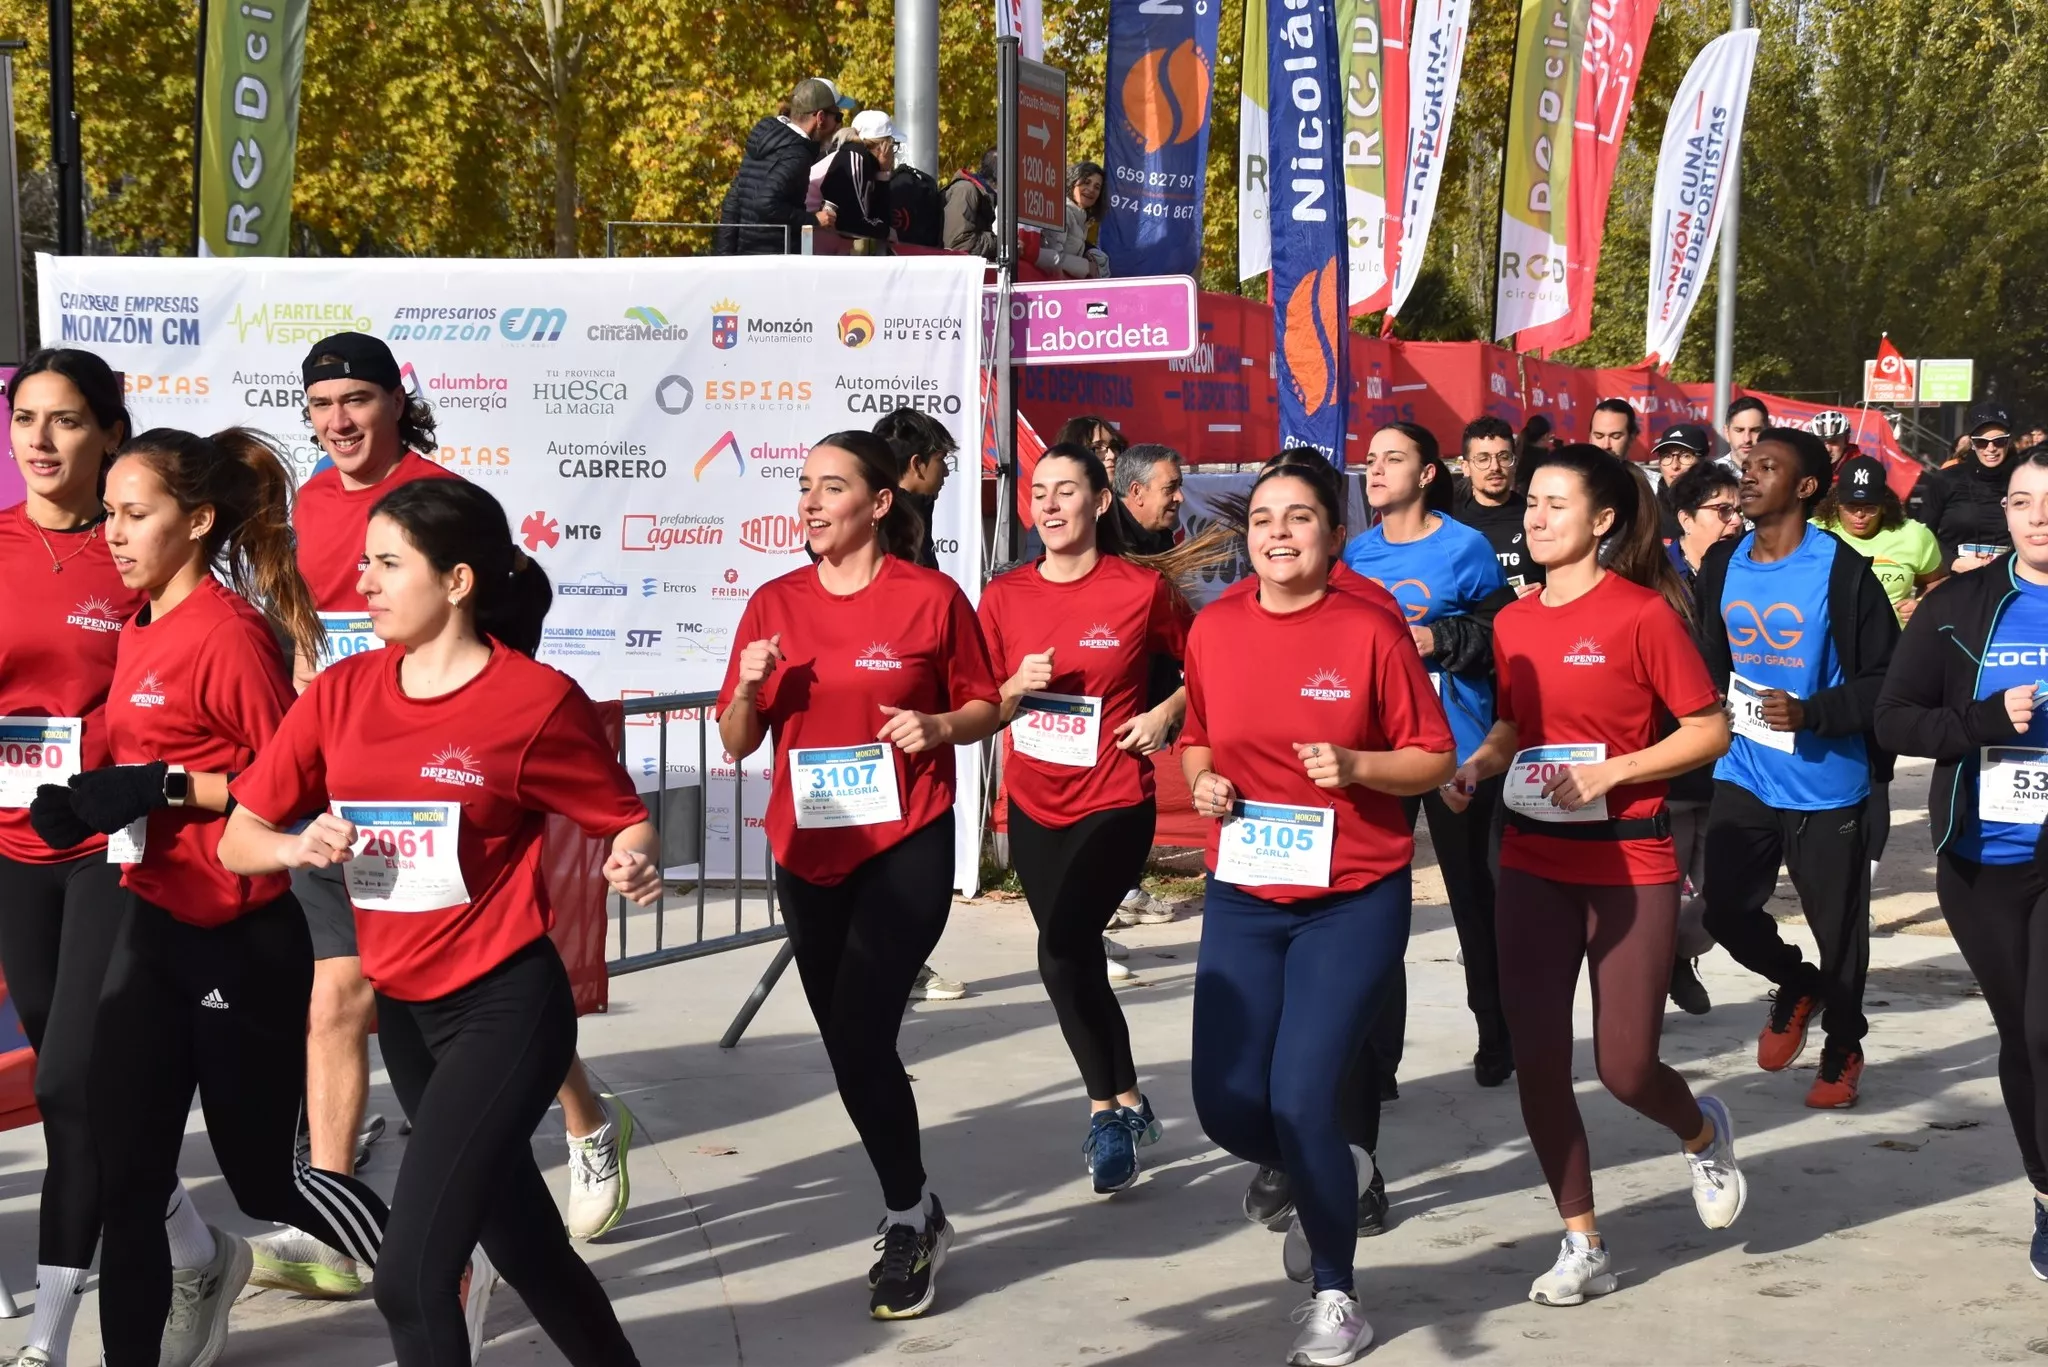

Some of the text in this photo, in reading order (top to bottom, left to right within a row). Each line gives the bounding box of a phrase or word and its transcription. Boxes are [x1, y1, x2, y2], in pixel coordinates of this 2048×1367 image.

[1022, 154, 1057, 188] 1200 de
[1116, 165, 1195, 189] 659 827 97
[1680, 136, 1705, 207] CUNA
[1024, 188, 1055, 220] 1250 m
[1110, 194, 1194, 220] 974 401 867
[1677, 105, 1728, 300] DE DEPORTISTAS
[60, 292, 199, 314] CARRERA EMPRESAS
[274, 304, 353, 320] FARTLECK
[394, 307, 497, 323] Empresarios
[747, 317, 813, 333] Monzón
[884, 316, 962, 329] DIPUTACIÓN
[162, 317, 200, 346] CM
[387, 321, 492, 341] monzón
[587, 325, 689, 341] CincaMedio
[884, 330, 962, 340] HUESCA
[1026, 322, 1170, 352] Labordeta
[747, 334, 813, 345] Ayuntamiento
[124, 374, 210, 396] SPIAS
[232, 370, 304, 385] Automóv
[429, 373, 508, 390] alumbra
[835, 375, 938, 390] Automóviles
[705, 381, 812, 401] ESPIAS
[1025, 368, 1134, 409] DE DEPORTISTAS
[245, 388, 307, 408] CABR
[439, 392, 507, 413] energía
[847, 394, 962, 415] CABRERO
[705, 403, 811, 411] CONSTRUCTORA
[440, 445, 510, 466] PIAS
[546, 441, 646, 456] Automóviles
[750, 442, 812, 460] alumb
[559, 459, 667, 479] CABRERO
[760, 464, 802, 479] ener
[660, 513, 724, 530] prefabricados
[565, 524, 602, 540] MTG
[647, 526, 724, 550] agustín
[1496, 552, 1520, 567] TG
[562, 586, 624, 595] coctramo
[663, 582, 697, 594] Ercros
[712, 588, 750, 597] FRIBIN
[67, 615, 122, 632] DEPENDE
[676, 623, 728, 635] TMC GRUPO
[625, 629, 662, 648] STF
[1079, 639, 1121, 647] DEPENDE
[855, 659, 903, 669] DEPENDE
[1563, 654, 1606, 664] DEPENDE
[1732, 653, 1805, 668] RUPO GRACIA
[1300, 688, 1351, 699] DEPENDE
[1745, 701, 1765, 721] 16
[1028, 710, 1086, 735] 2058
[1748, 718, 1768, 729] JUAN
[855, 748, 881, 759] MONZÓN
[420, 766, 485, 787] DEPENDE
[711, 768, 748, 778] FRIBN
[811, 763, 877, 789] 3107
[810, 785, 879, 798] SARA ALEGRÍA
[413, 809, 444, 822] MONZÓN
[1295, 813, 1321, 823] MONZÓN
[360, 829, 435, 858] 2061
[1241, 822, 1314, 851] 3105
[1256, 847, 1290, 859] CARLA
[385, 859, 416, 870] ELISA
[201, 999, 229, 1009] adidas
